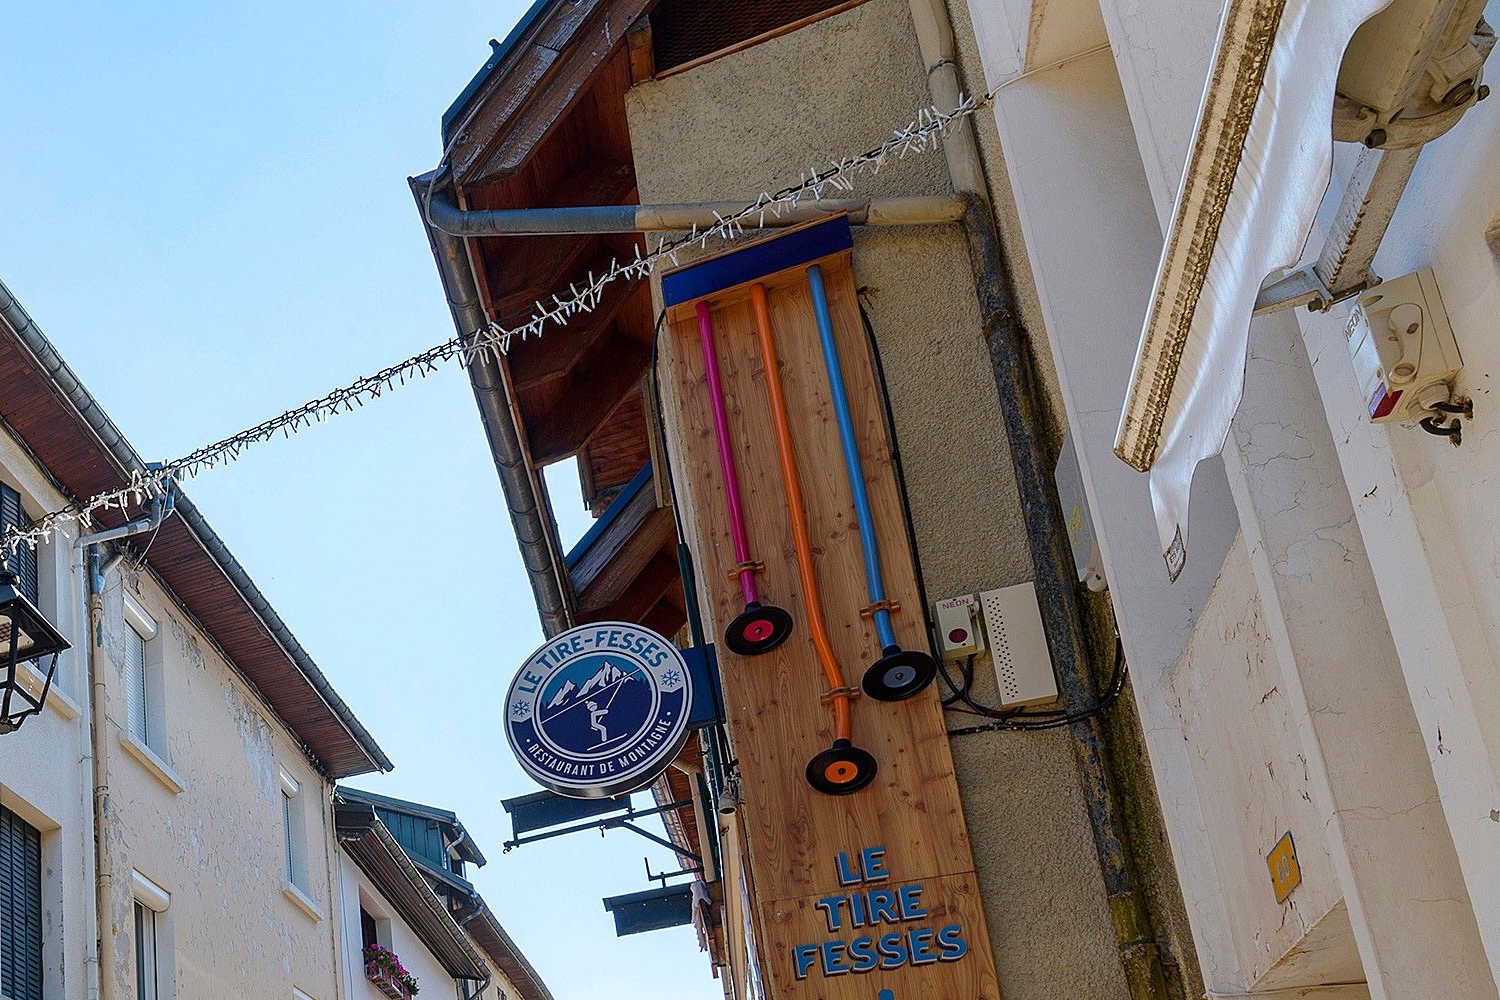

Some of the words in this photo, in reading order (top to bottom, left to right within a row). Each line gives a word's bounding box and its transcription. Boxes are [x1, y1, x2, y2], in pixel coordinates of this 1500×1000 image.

[942, 598, 969, 610] NEON
[518, 671, 543, 694] LE
[535, 630, 669, 669] TIRE-FESSES
[528, 742, 595, 776] RESTAURANT
[600, 763, 615, 775] DE
[619, 718, 672, 768] MONTAGNE
[835, 845, 890, 886] LE
[817, 884, 928, 932] TIRE
[792, 924, 970, 980] FESSES
